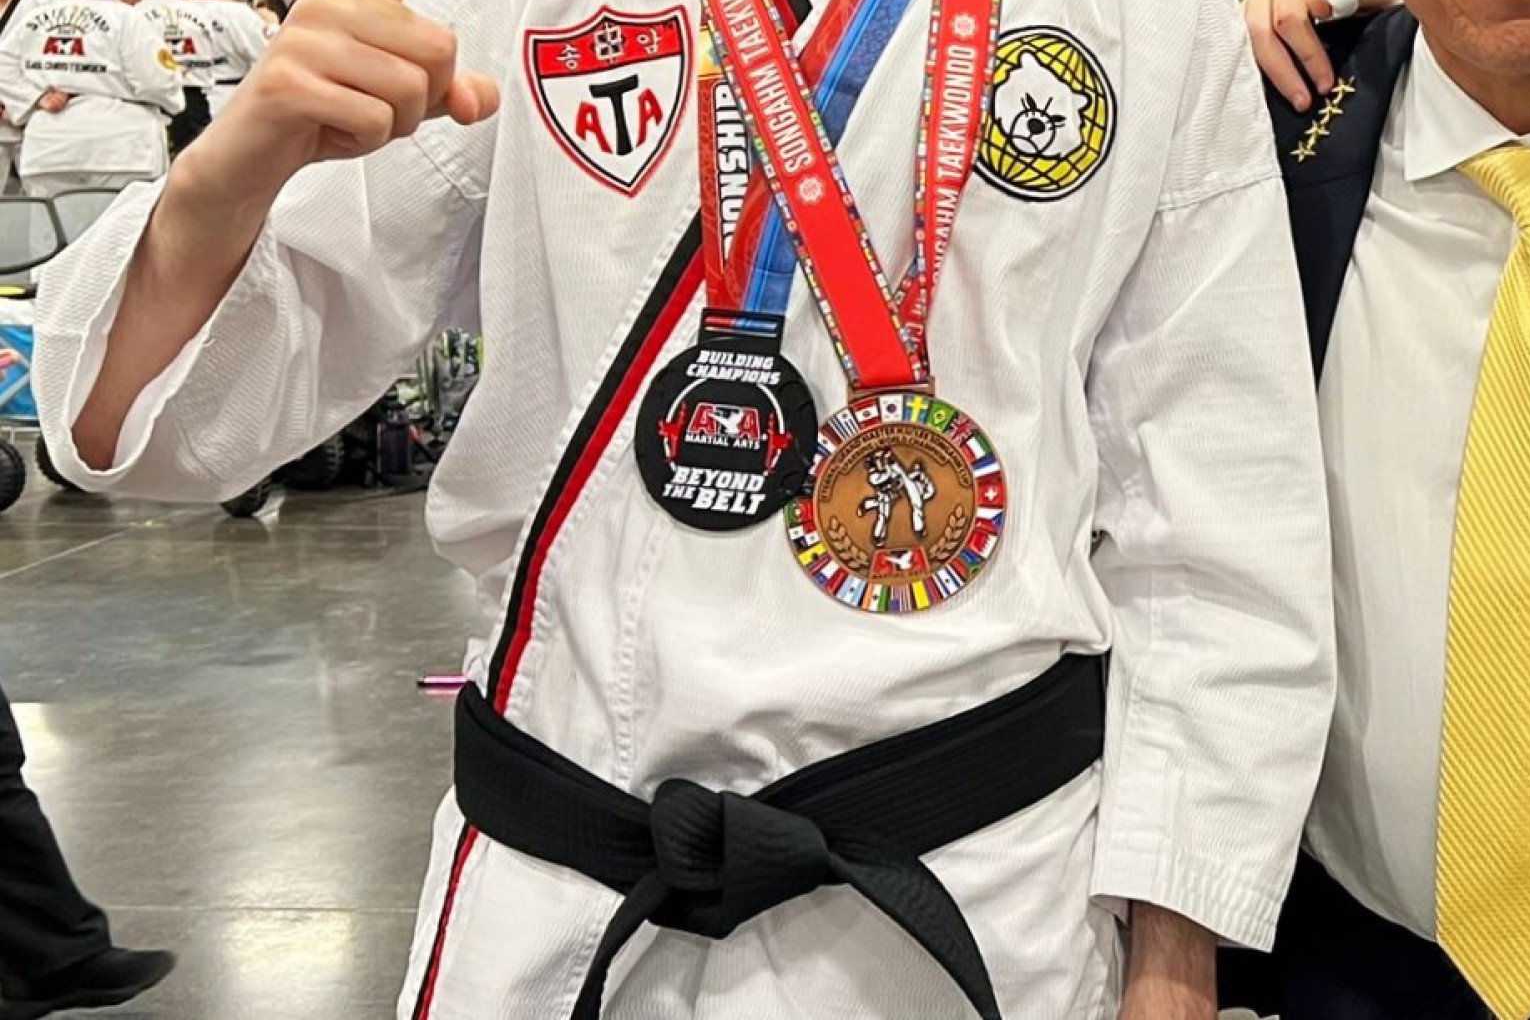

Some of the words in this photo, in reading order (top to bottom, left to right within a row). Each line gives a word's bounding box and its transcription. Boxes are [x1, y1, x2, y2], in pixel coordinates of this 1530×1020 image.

[575, 74, 664, 156] ATA
[751, 61, 813, 174] SONGAHM
[937, 45, 976, 179] TAEKWONDO
[685, 363, 781, 385] CHAMPIONS
[697, 349, 774, 370] BUILDING
[686, 401, 762, 442] ATA
[684, 433, 729, 447] MARTIAL
[732, 436, 761, 450] ARTS
[671, 465, 766, 492] BEYOND
[662, 483, 695, 500] THE
[691, 487, 766, 516] BELT
